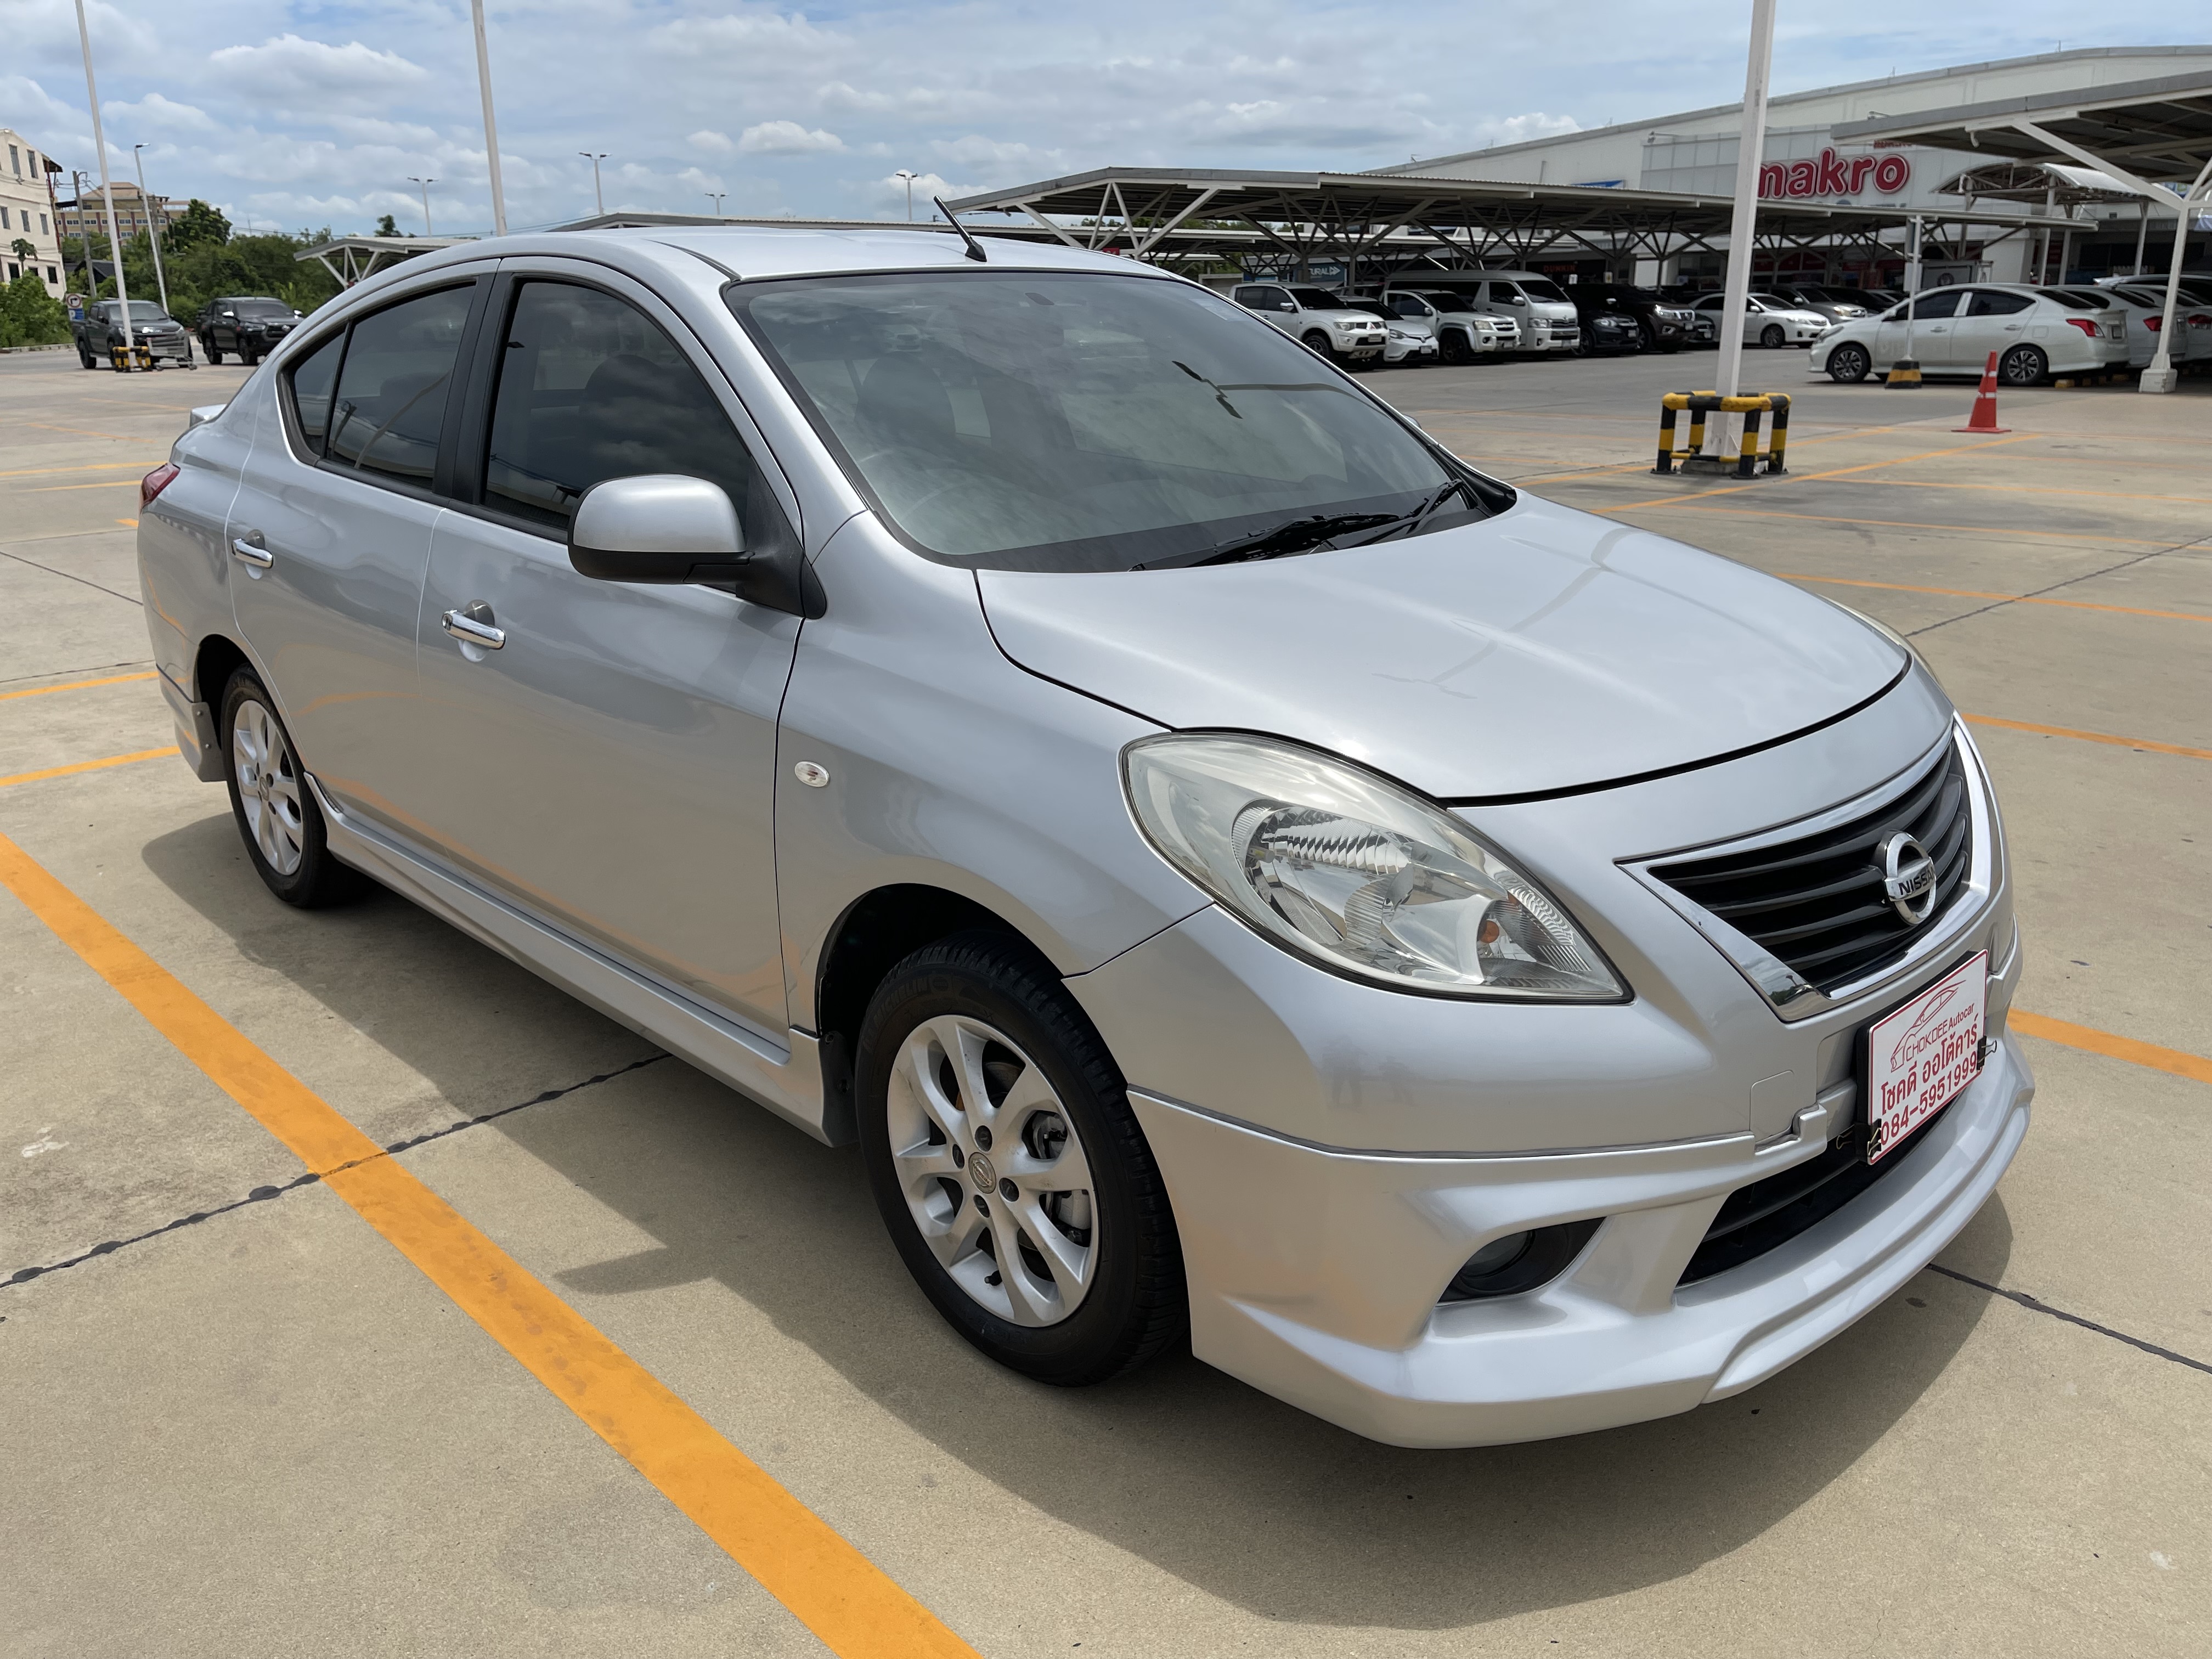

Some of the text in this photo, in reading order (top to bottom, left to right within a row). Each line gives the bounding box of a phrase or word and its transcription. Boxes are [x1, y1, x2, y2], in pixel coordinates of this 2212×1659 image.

[1881, 1012, 1979, 1116] โชคดี ออโต้คาร์
[1906, 1002, 1975, 1062] CHOKDEE Autocar
[1881, 1051, 1977, 1146] 084-5951999
